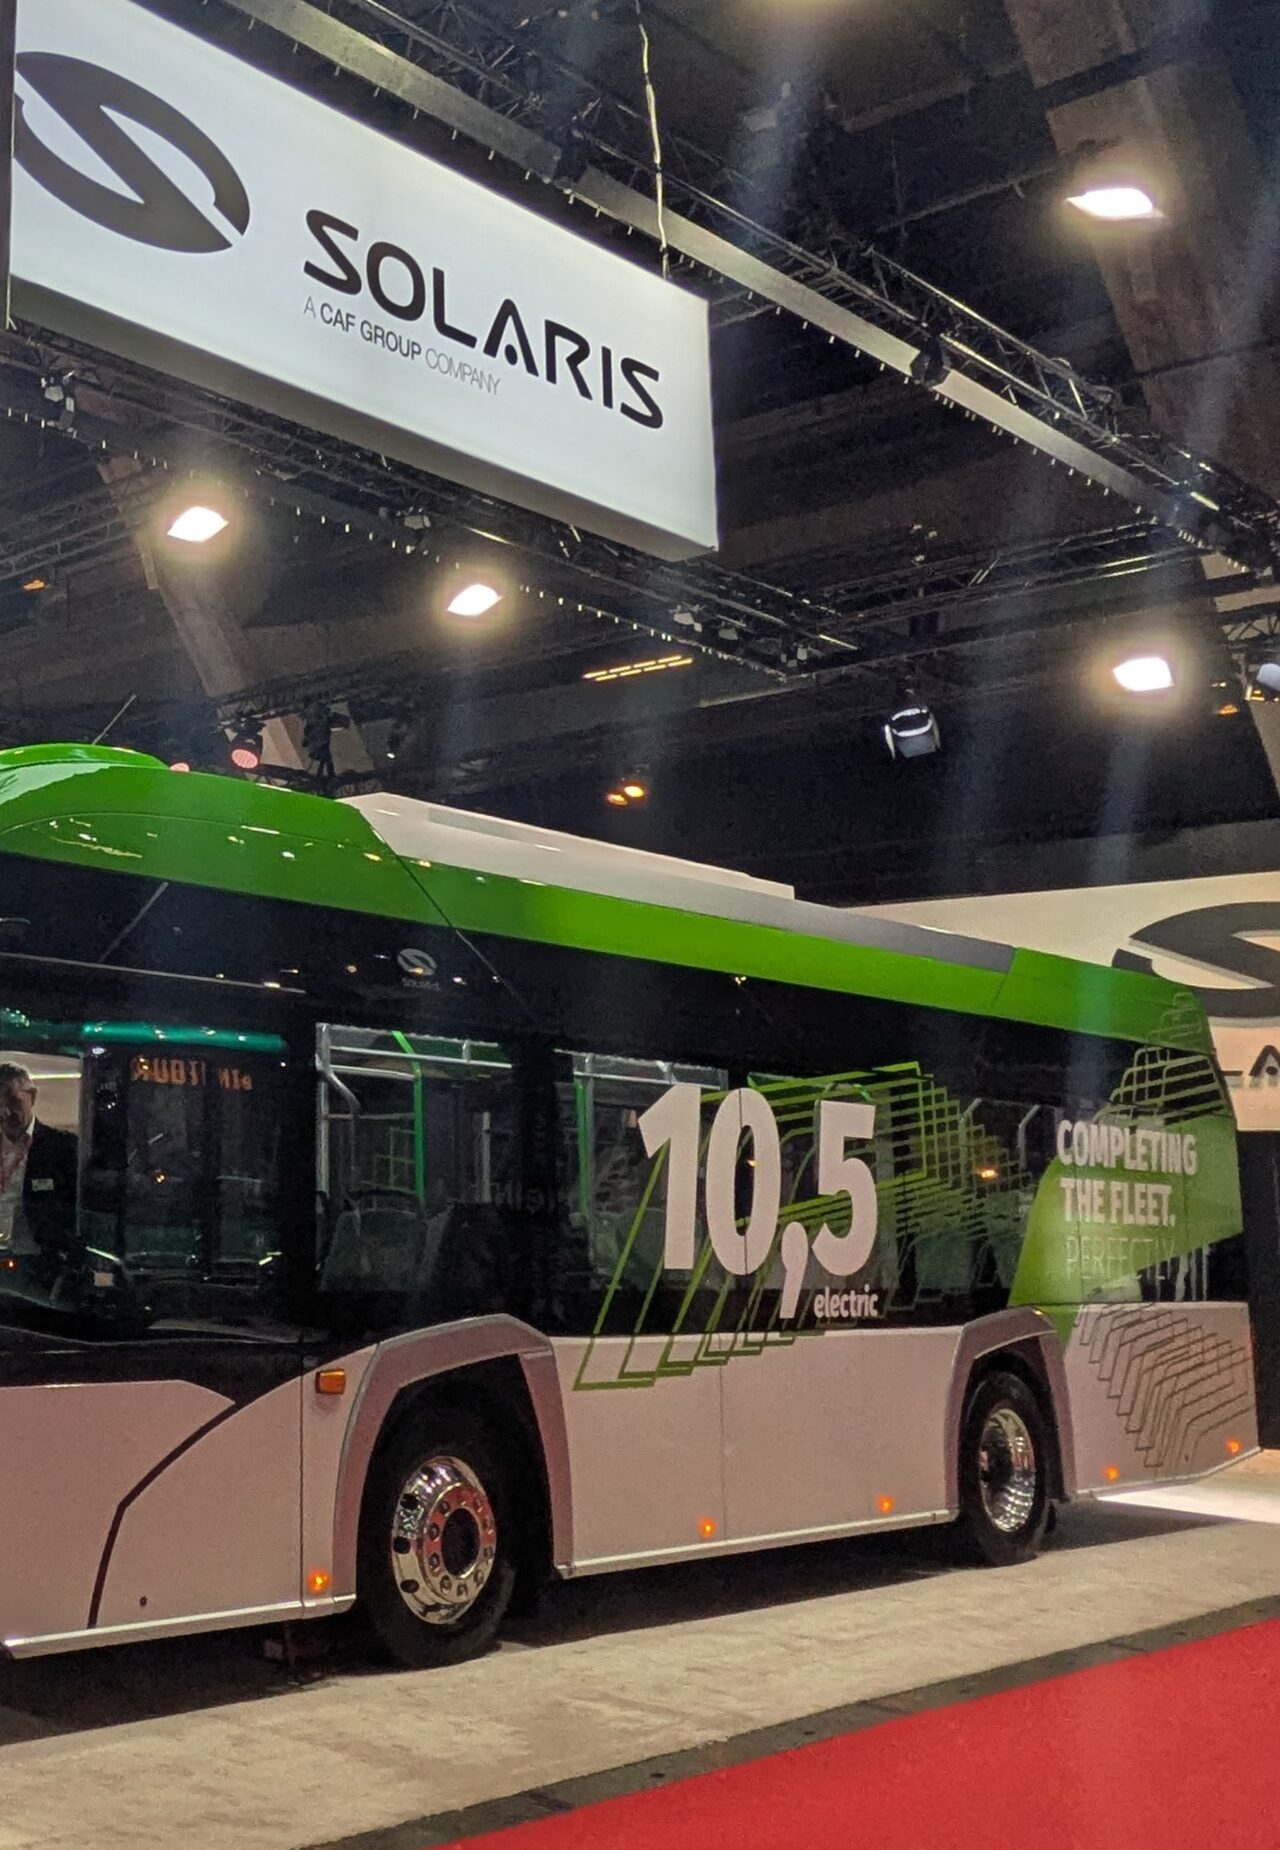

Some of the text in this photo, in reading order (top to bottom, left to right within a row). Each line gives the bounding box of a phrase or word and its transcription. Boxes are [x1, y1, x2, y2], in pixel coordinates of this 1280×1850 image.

[303, 296, 501, 396] A CAF GROUP COMPANY
[304, 209, 663, 429] SOLARIS
[1057, 1120, 1198, 1176] COMPLETING
[638, 1082, 878, 1319] 10,5
[1060, 1178, 1176, 1227] THE FLEET.
[814, 1284, 879, 1317] electric
